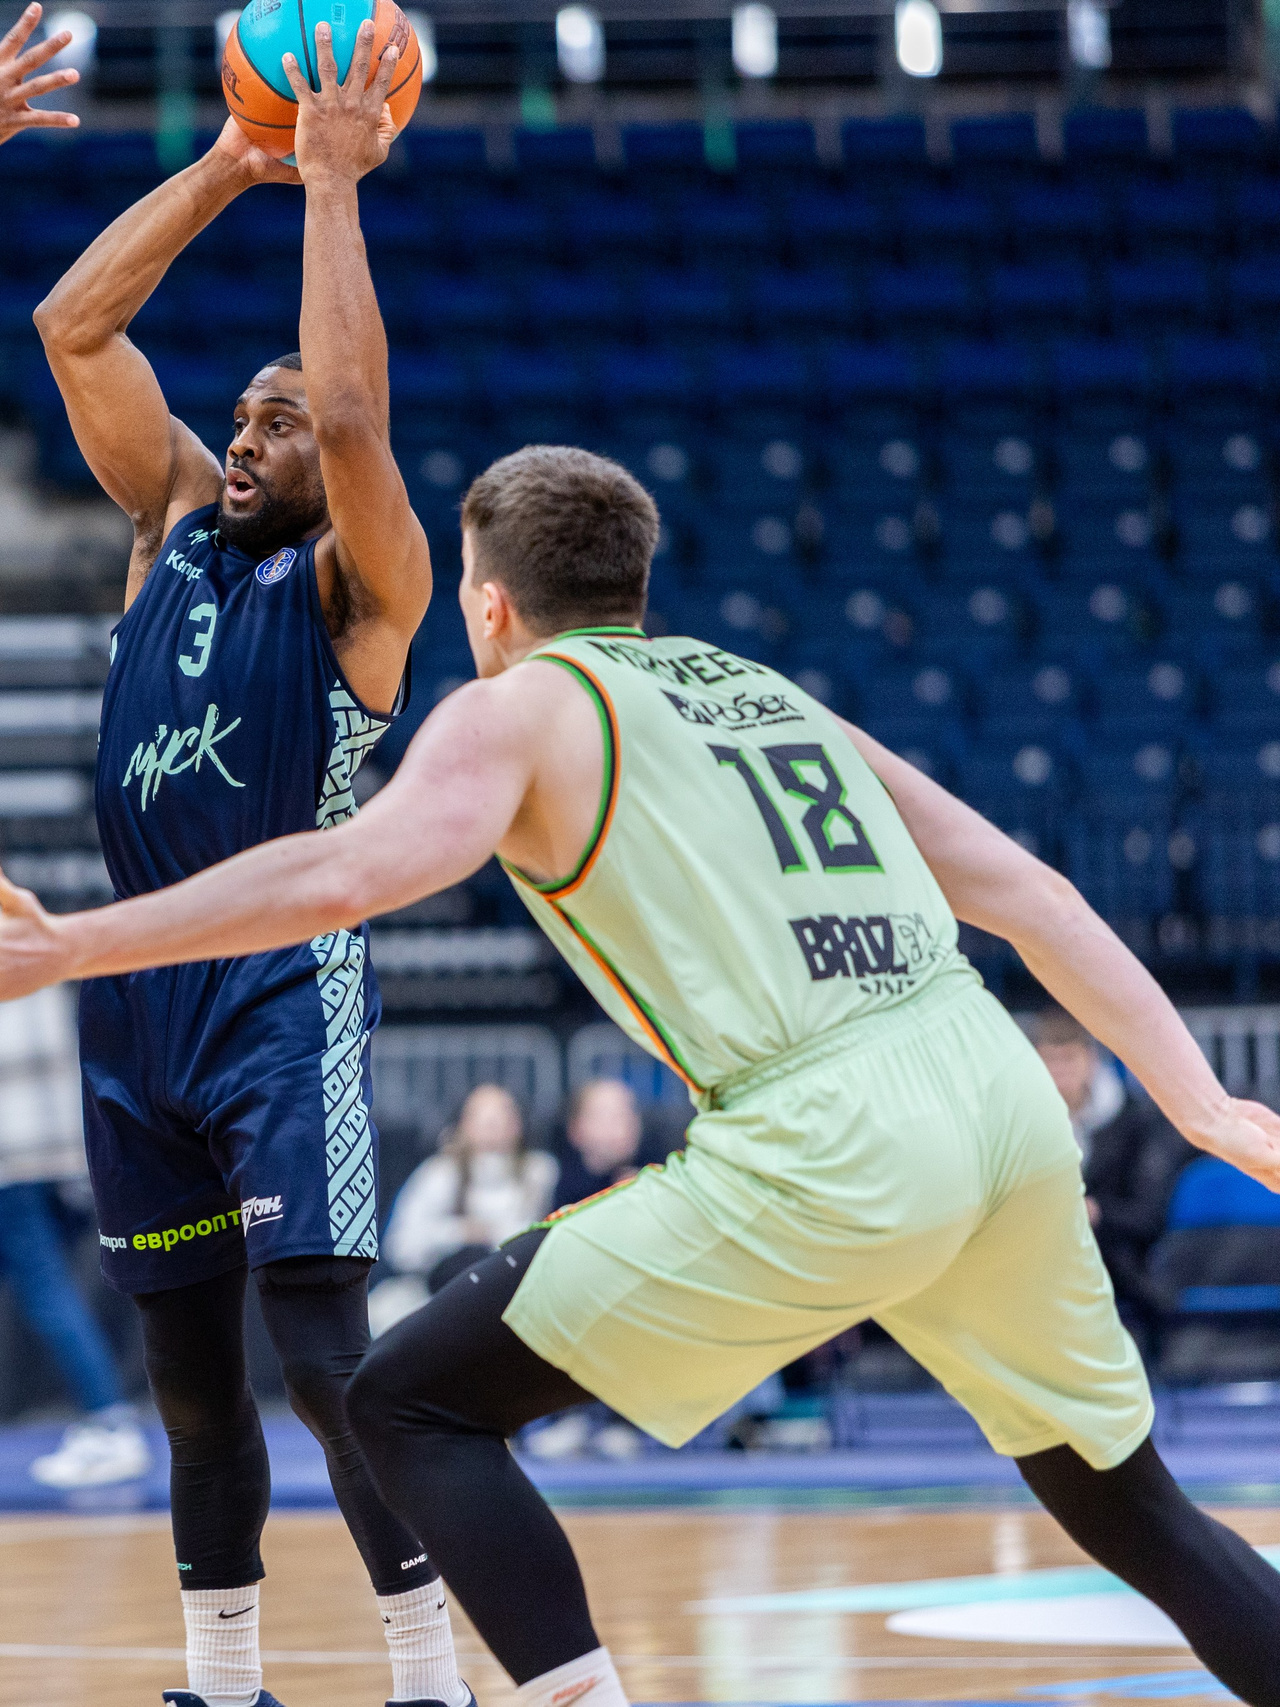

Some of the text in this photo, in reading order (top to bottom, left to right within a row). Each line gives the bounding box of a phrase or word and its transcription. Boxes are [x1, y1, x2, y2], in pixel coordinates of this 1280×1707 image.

[178, 602, 217, 677] 3
[706, 742, 886, 875] 18
[98, 1229, 127, 1252] empa
[132, 1209, 241, 1252] евроопт
